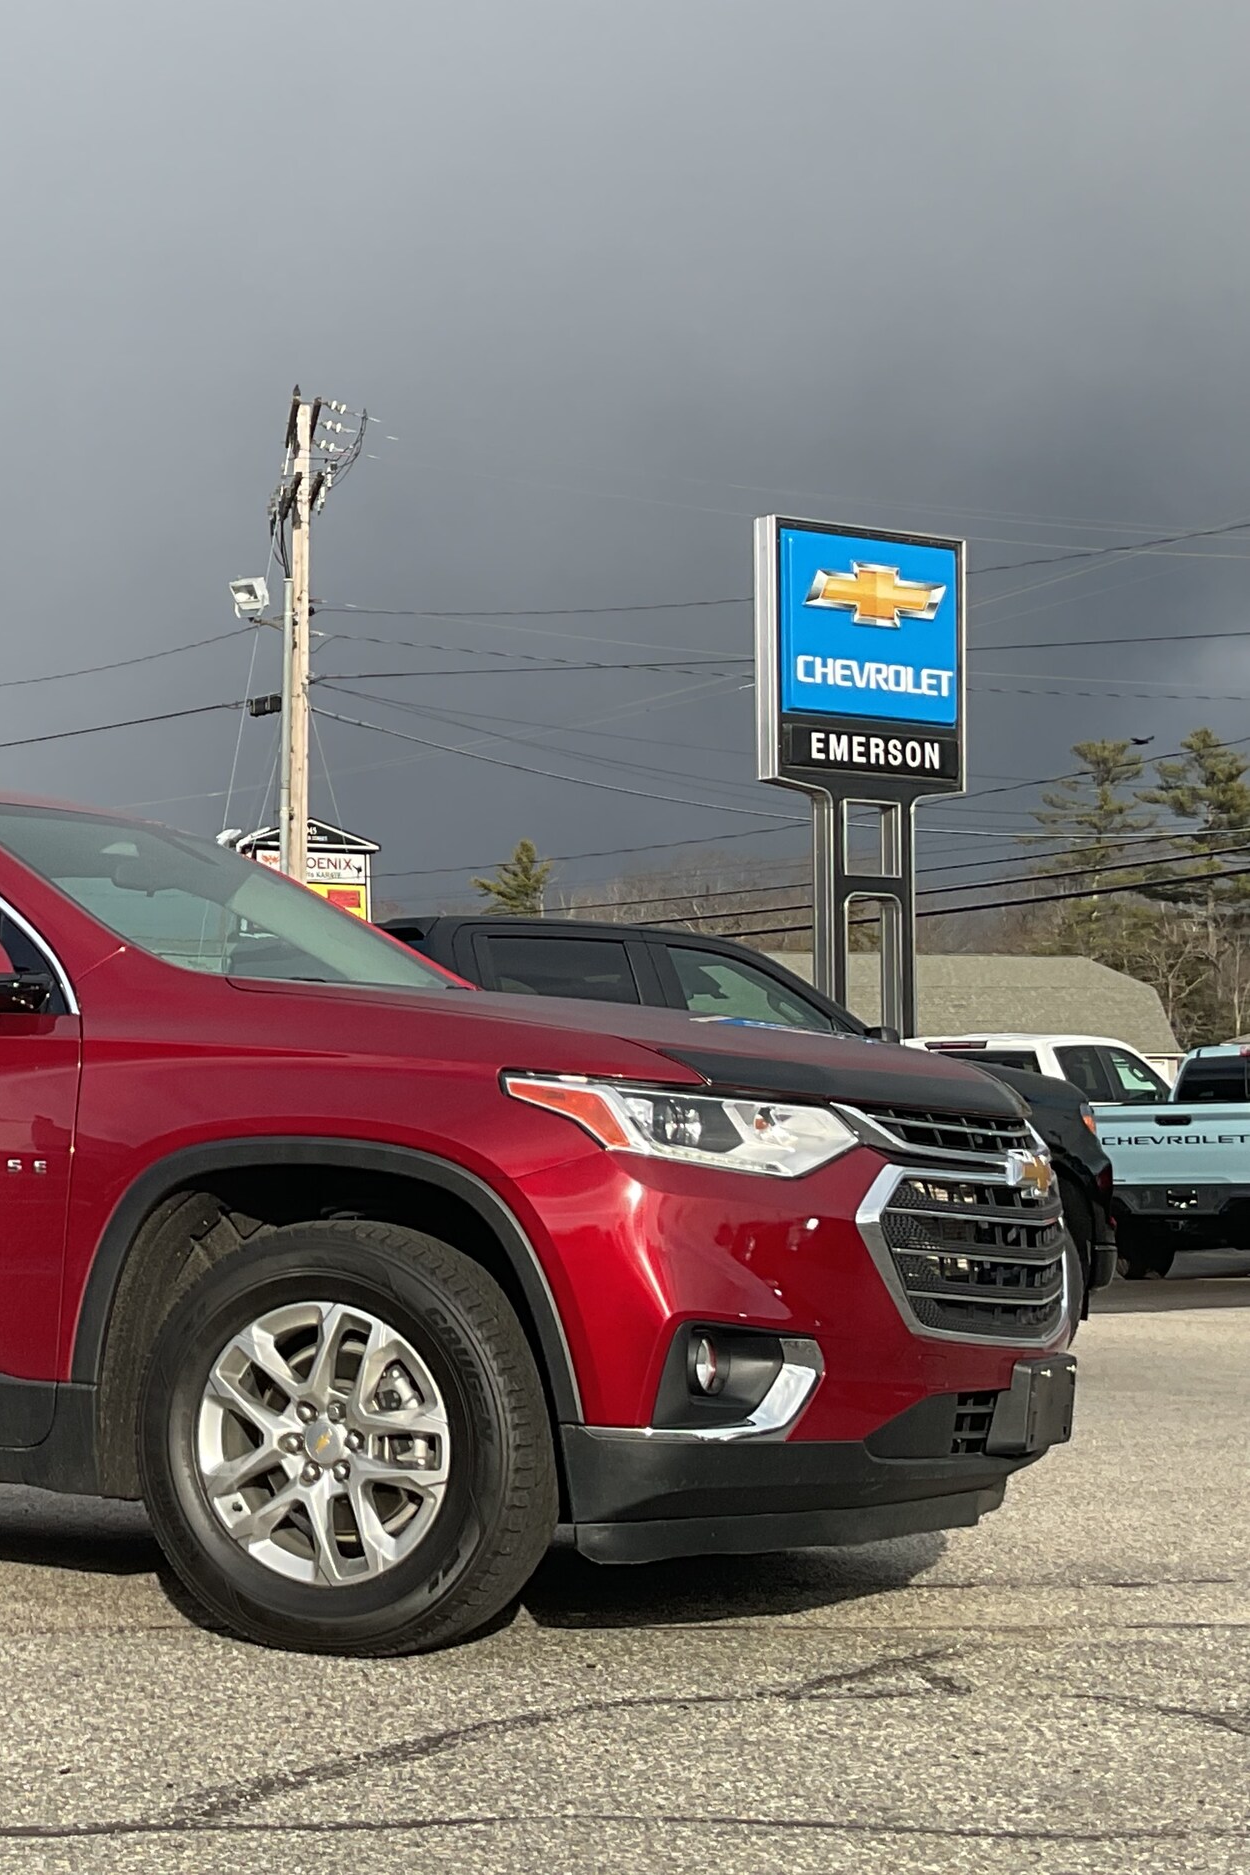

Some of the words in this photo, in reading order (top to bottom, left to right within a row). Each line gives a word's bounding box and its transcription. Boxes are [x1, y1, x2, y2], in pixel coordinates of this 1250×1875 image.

[796, 655, 953, 697] CHEVROLET
[810, 731, 940, 770] EMERSON
[306, 857, 352, 870] OENIX
[1101, 1134, 1250, 1146] CHEVROLET
